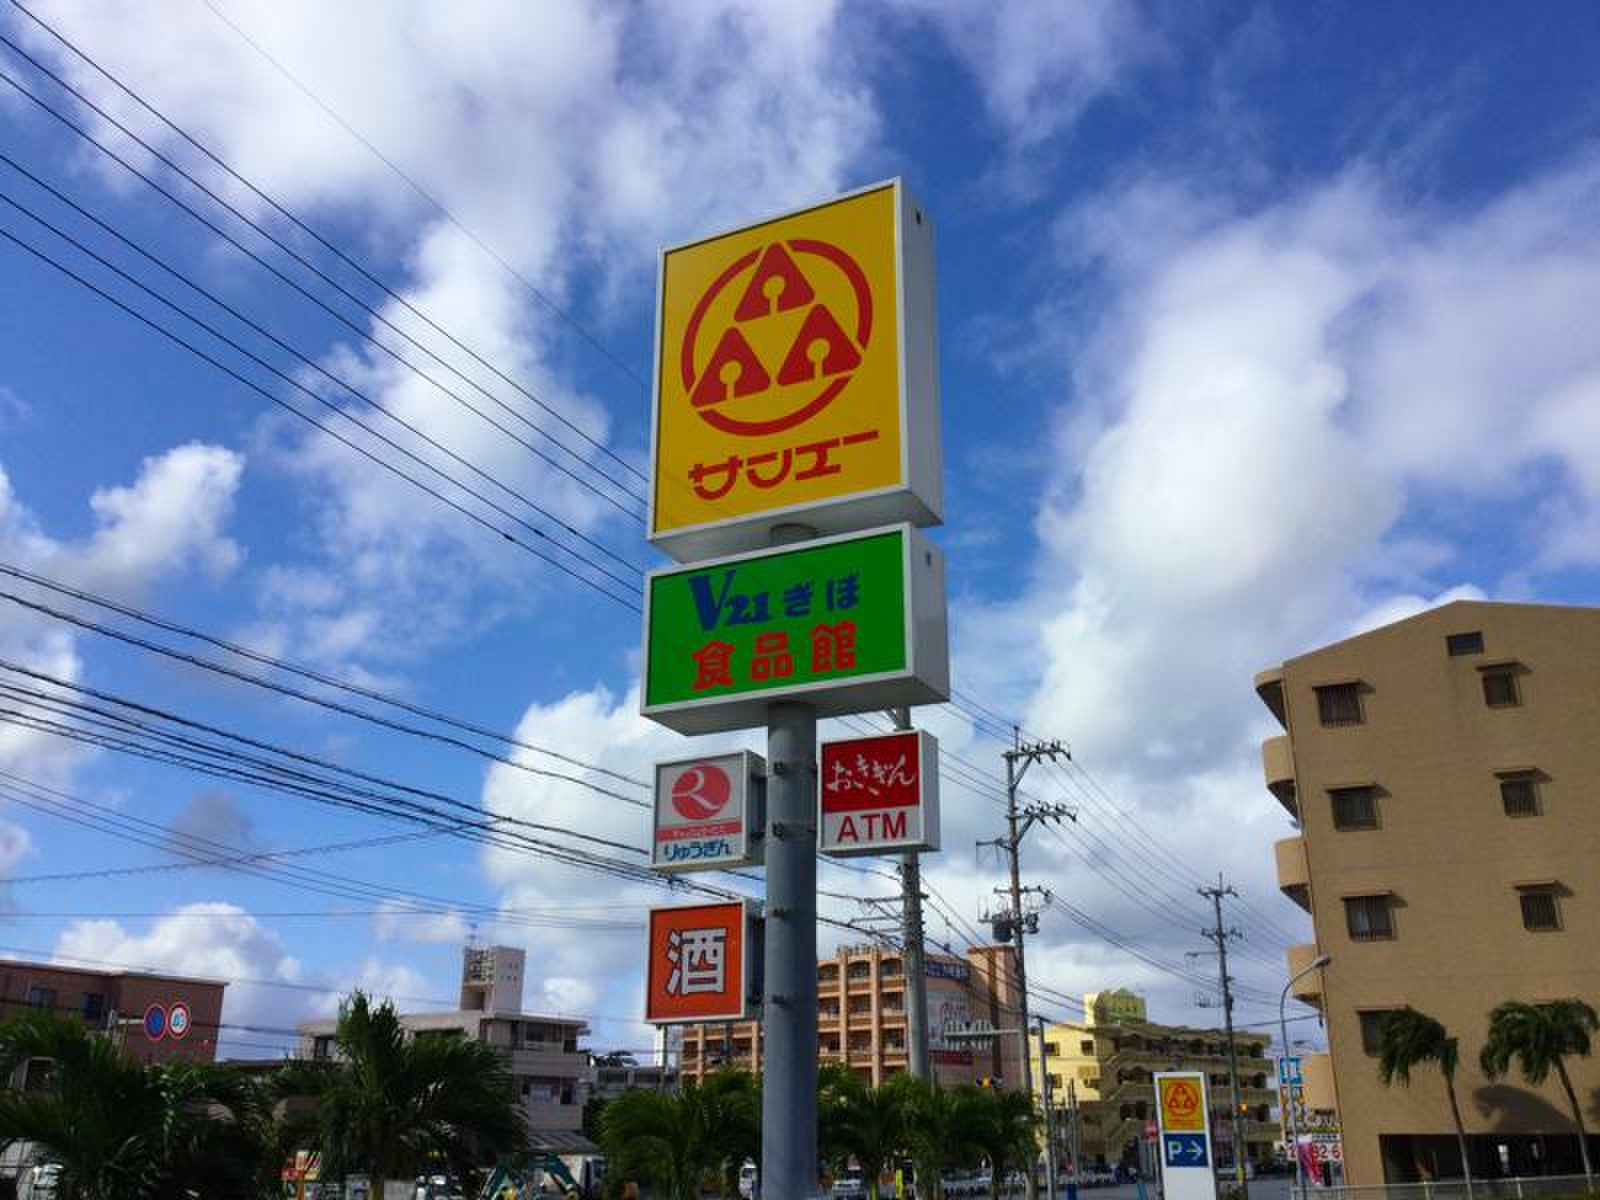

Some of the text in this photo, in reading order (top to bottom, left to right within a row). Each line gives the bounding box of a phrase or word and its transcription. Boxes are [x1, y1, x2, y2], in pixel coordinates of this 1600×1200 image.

[688, 430, 879, 500] サンエー
[691, 620, 857, 691] 食品館
[664, 839, 730, 862] りゅうぎん
[837, 812, 907, 843] ATM
[666, 927, 728, 997] 酒
[1167, 1140, 1183, 1161] P
